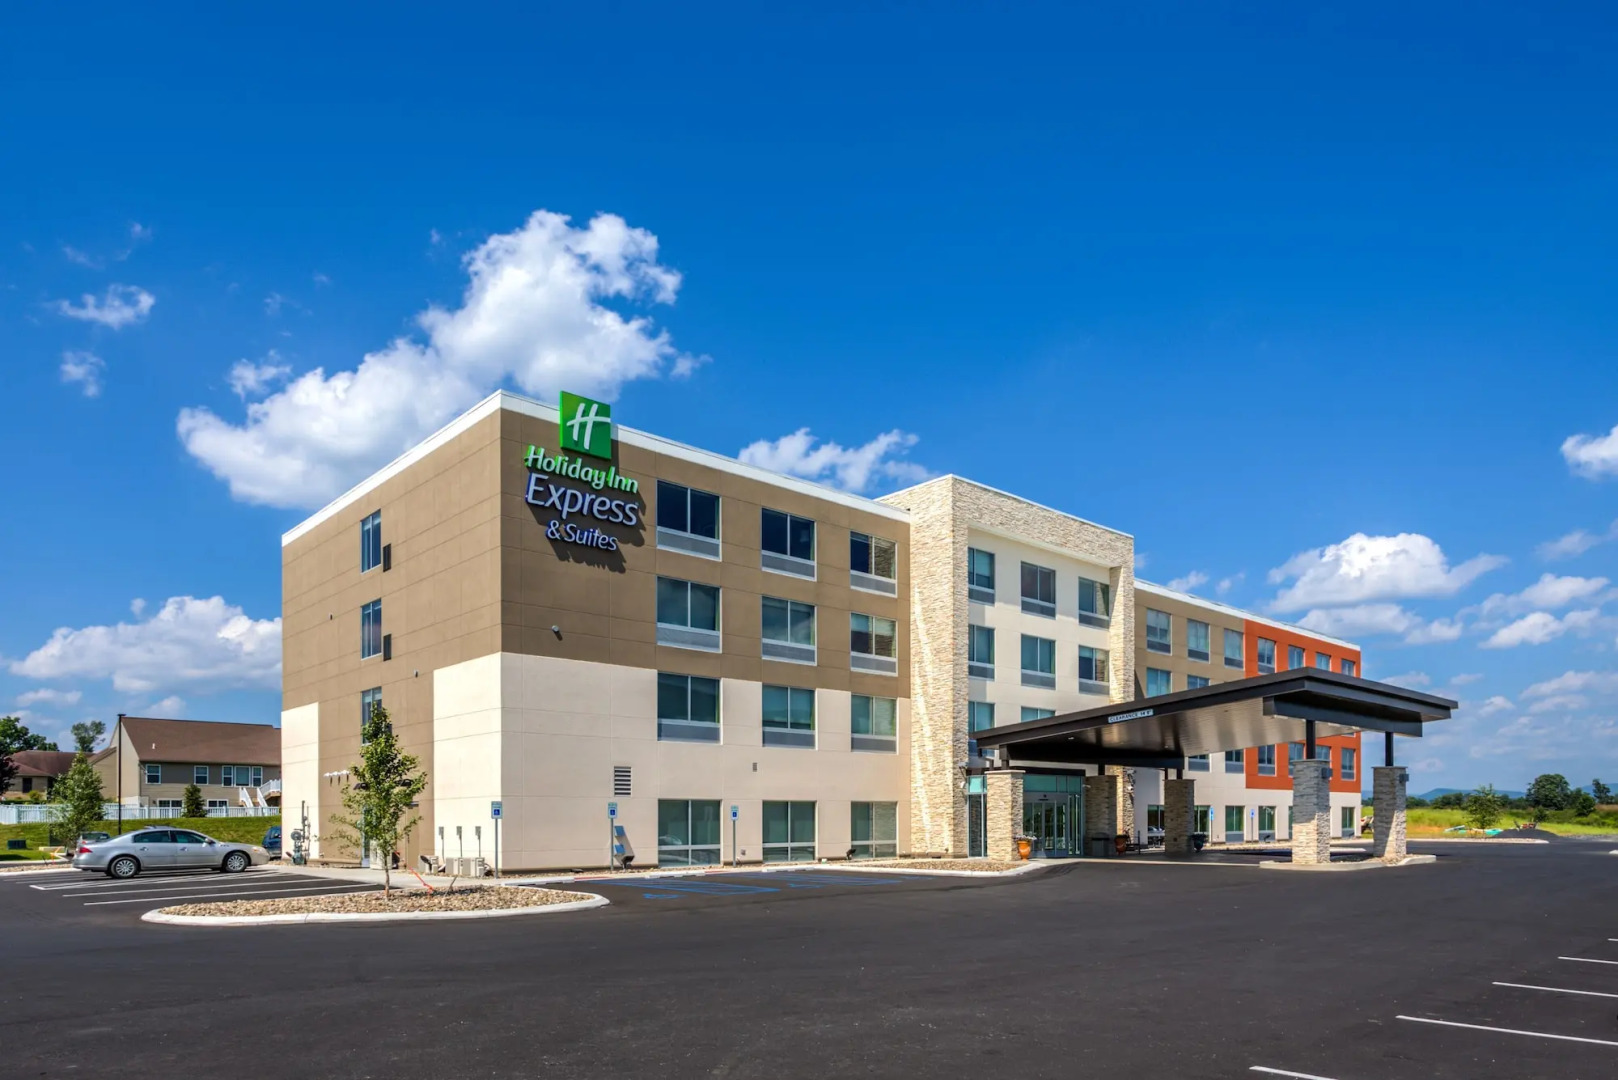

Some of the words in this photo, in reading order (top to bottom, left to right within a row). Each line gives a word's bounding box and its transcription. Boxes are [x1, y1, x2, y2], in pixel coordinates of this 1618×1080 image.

[566, 402, 611, 450] H
[524, 444, 605, 490] Holiday
[606, 466, 639, 494] Inn
[526, 472, 639, 526] Express
[546, 519, 560, 541] &
[564, 523, 618, 551] Suites
